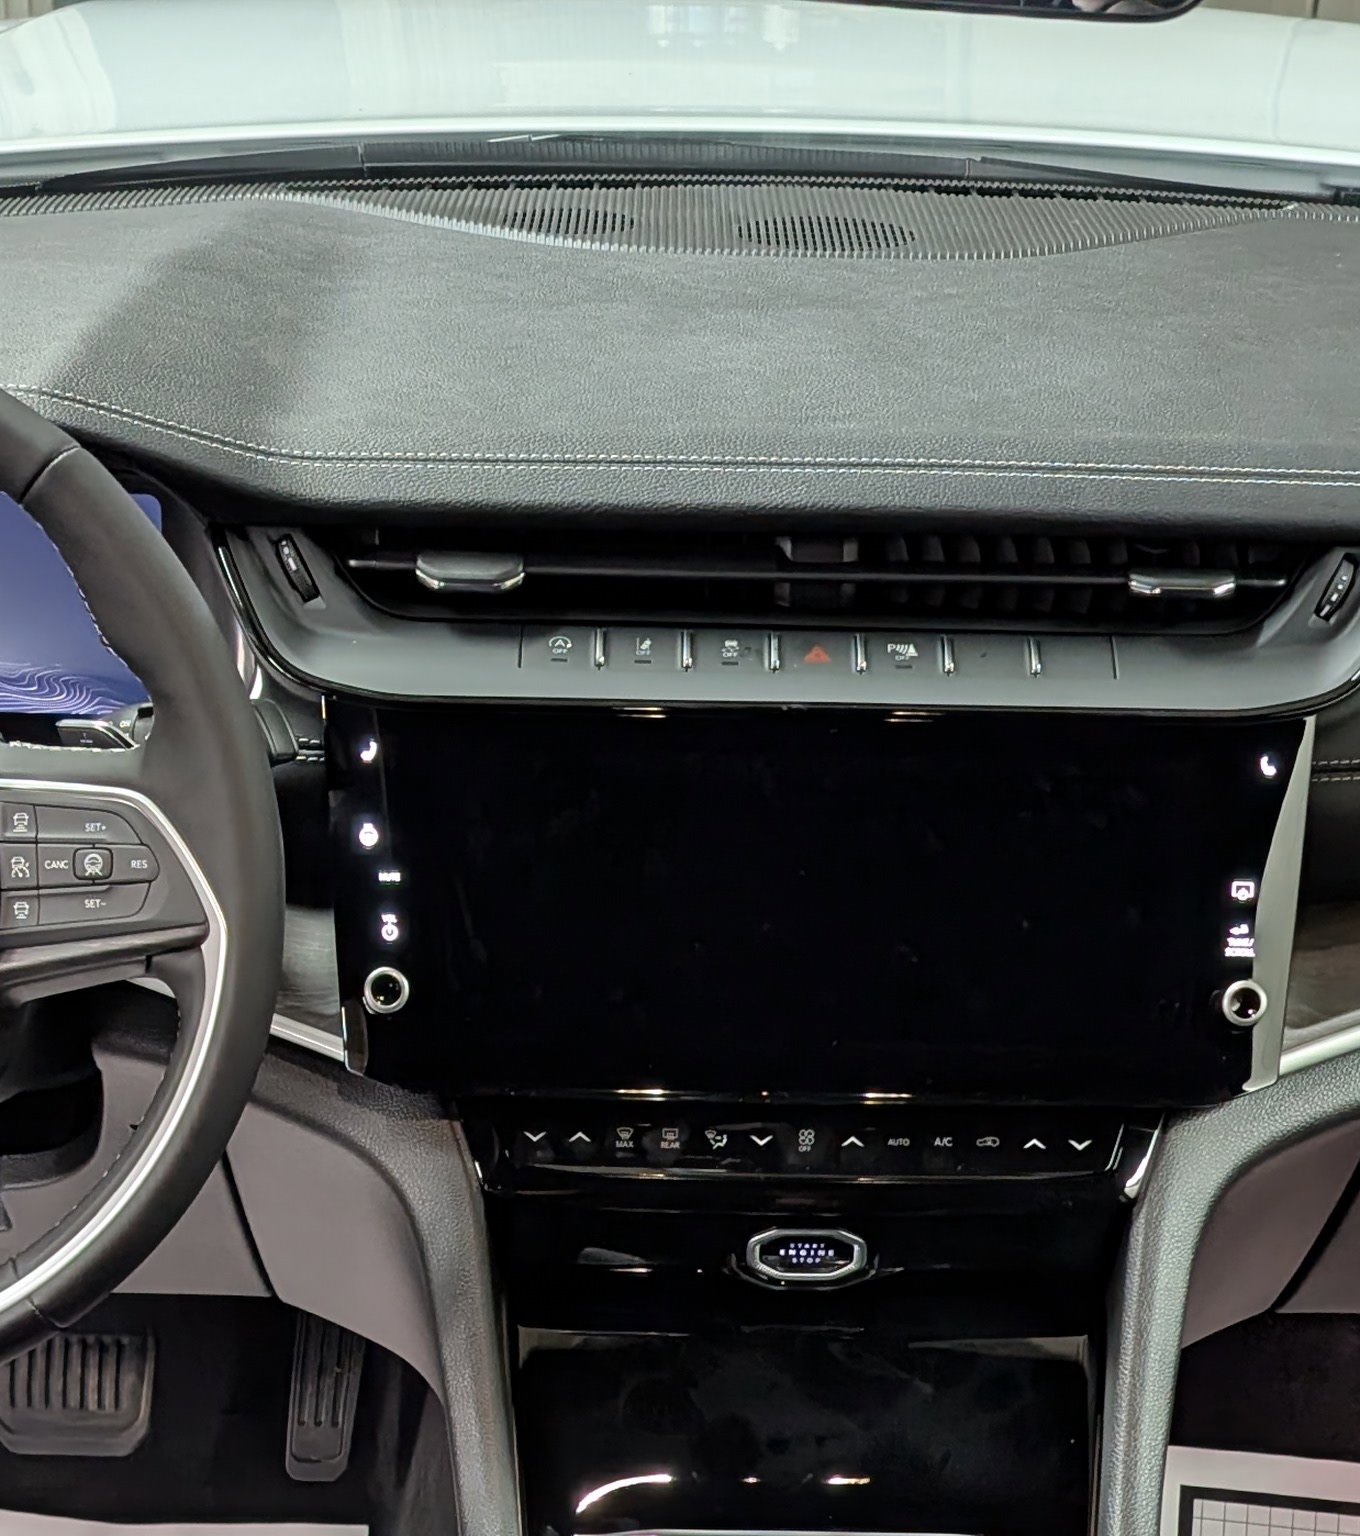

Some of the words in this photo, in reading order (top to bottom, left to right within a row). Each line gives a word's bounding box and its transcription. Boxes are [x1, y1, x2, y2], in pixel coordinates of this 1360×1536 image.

[44, 859, 69, 869] CANC
[130, 859, 148, 869] RES
[615, 1140, 634, 1148] MAX
[660, 1141, 681, 1149] REAR
[888, 1138, 911, 1146] AUTO
[934, 1137, 953, 1147] A/C
[778, 1249, 835, 1257] ENGINE
